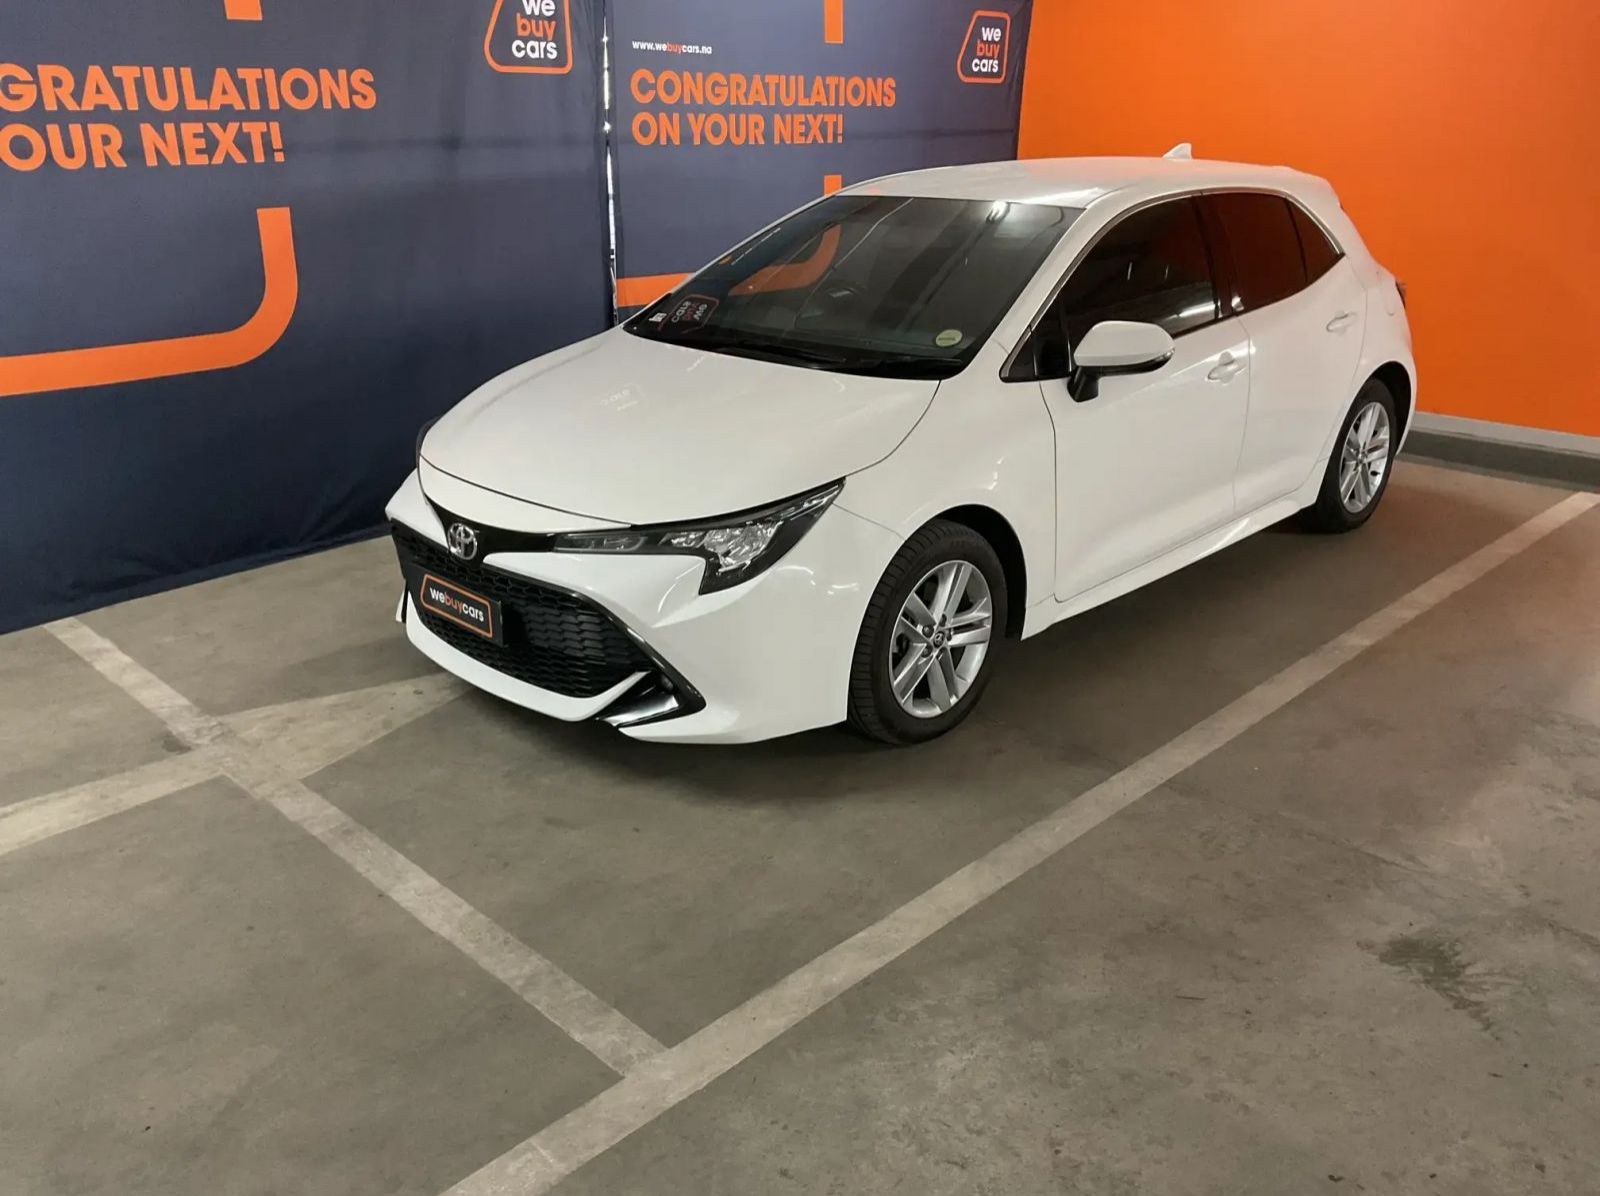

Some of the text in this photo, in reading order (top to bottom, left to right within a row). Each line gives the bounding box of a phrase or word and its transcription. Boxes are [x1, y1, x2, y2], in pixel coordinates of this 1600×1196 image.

[522, 0, 556, 17] we
[516, 12, 557, 41] buy
[981, 26, 1002, 42] we
[511, 39, 558, 59] cars
[631, 40, 713, 55] www.webuycars.na
[976, 38, 1000, 60] buy
[971, 58, 999, 73] cars
[630, 68, 897, 108] CONGRATULATIONS
[631, 111, 843, 146] ON YOUR NEXT!
[140, 121, 285, 167] NEXT!
[429, 586, 485, 623] webuycars
